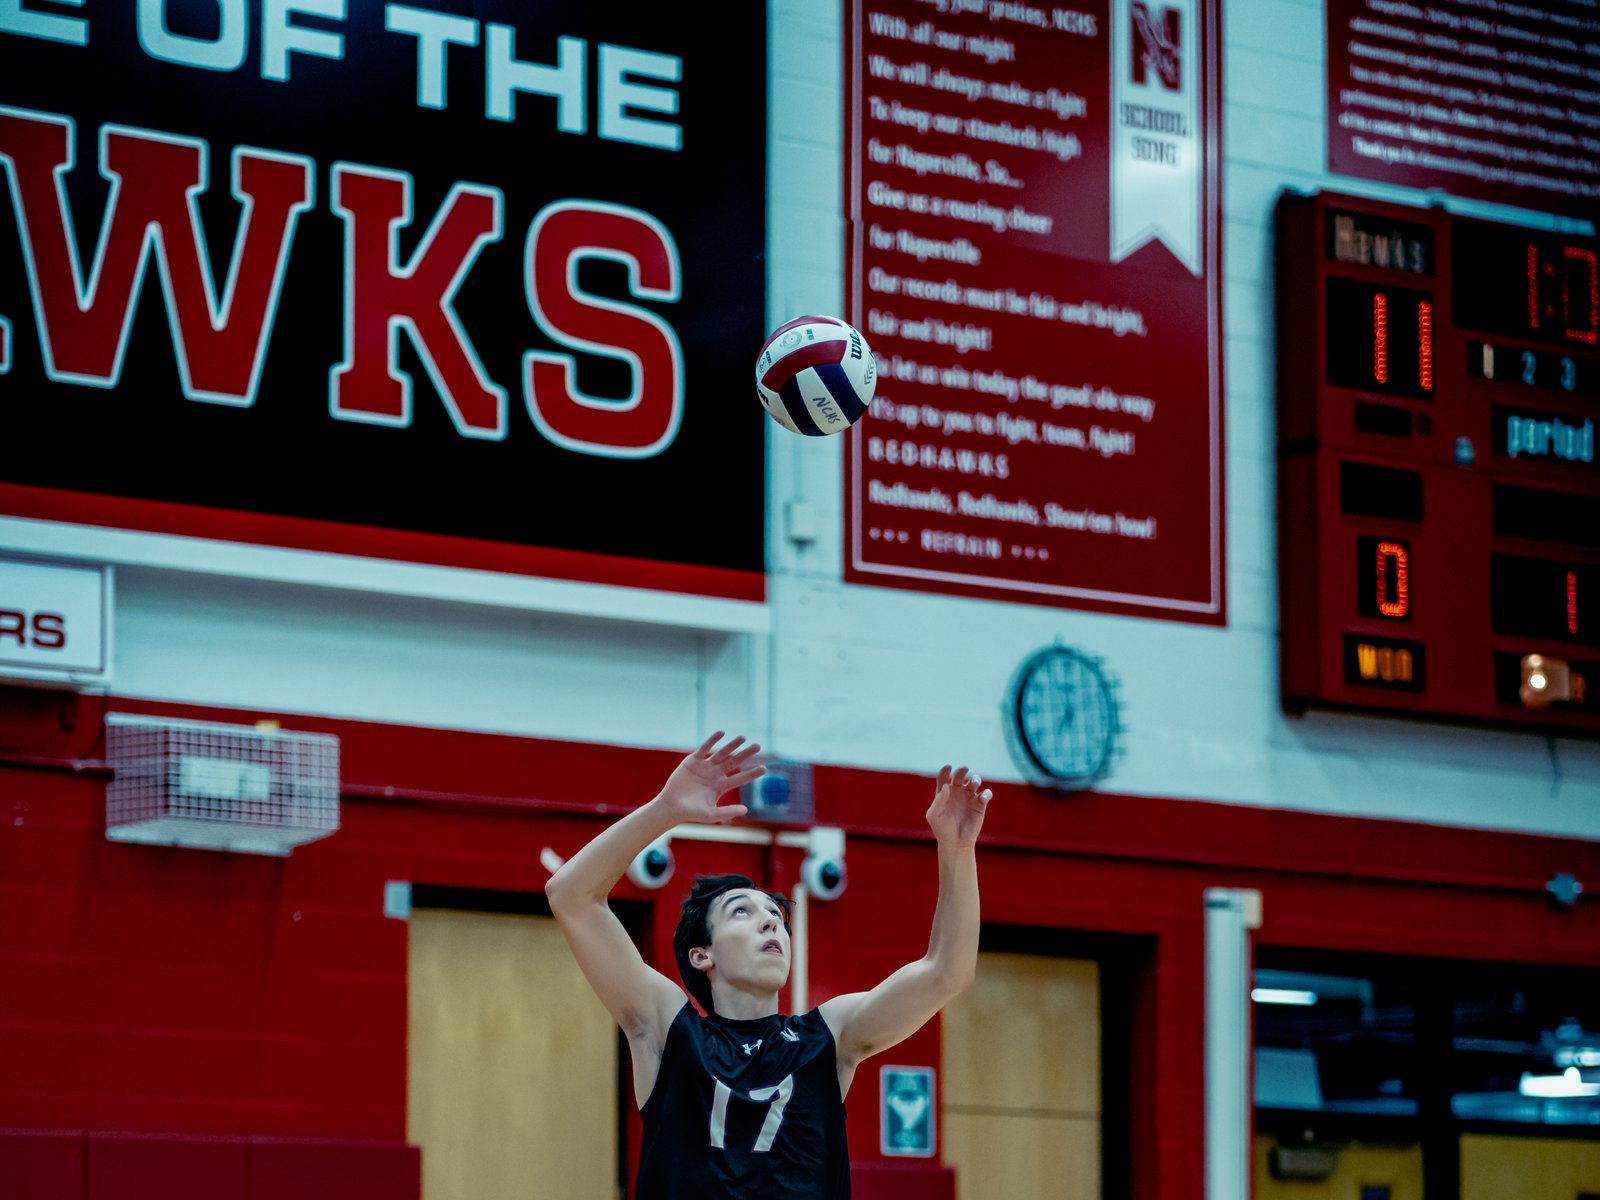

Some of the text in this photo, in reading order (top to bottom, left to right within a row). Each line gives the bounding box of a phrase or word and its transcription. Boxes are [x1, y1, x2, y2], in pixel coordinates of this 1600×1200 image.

[1053, 9, 1096, 35] NCHS
[136, 0, 346, 81] OF
[384, 3, 682, 151] THE
[1120, 102, 1192, 138] SCHOOL
[1131, 136, 1178, 166] SONG
[1335, 214, 1424, 274] Hawks
[1373, 293, 1433, 390] 11
[1522, 351, 1537, 385] 2
[1560, 357, 1576, 391] 3
[812, 397, 841, 424] NCHS
[1507, 415, 1594, 462] period
[1376, 541, 1409, 617] 0
[1566, 571, 1577, 633] 1
[1357, 644, 1413, 682] won
[710, 1073, 794, 1152] 17
